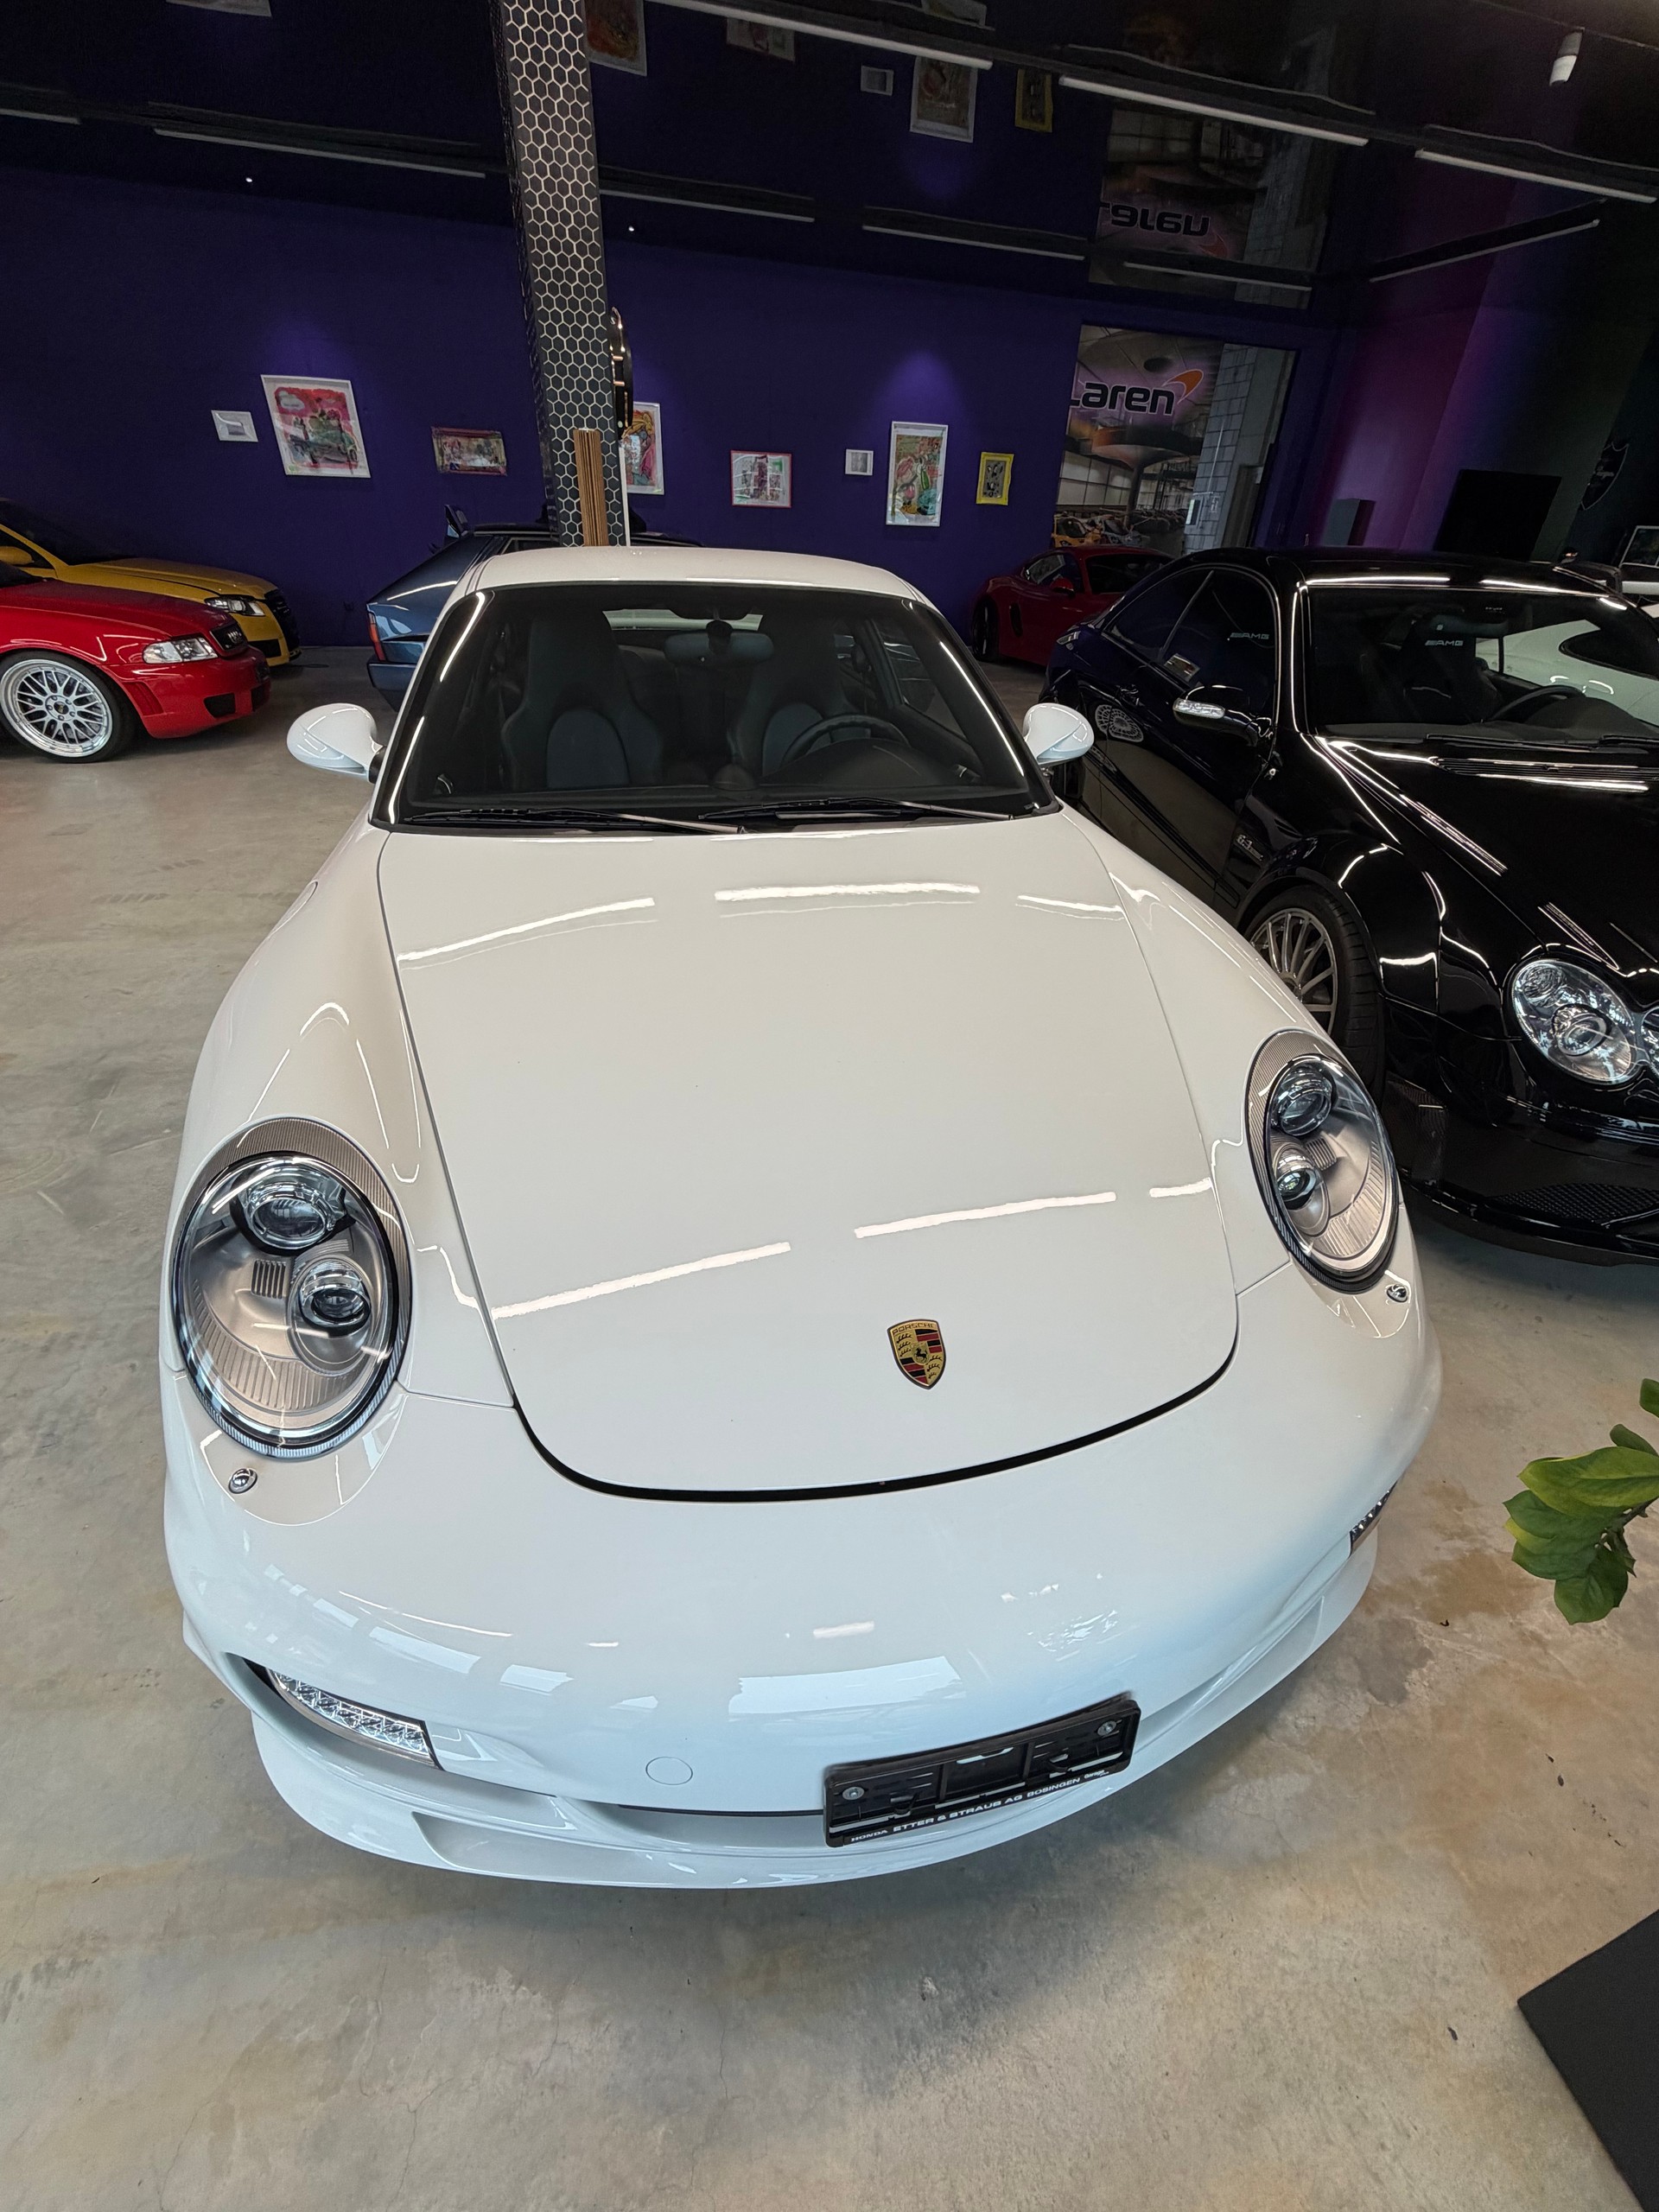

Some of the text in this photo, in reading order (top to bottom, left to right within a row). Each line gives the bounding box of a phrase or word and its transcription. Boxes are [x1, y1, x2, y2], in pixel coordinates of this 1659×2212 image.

[892, 1322, 938, 1336] PORSCHE
[850, 1829, 888, 1842] HONDA
[893, 1818, 935, 1833] ETTER
[949, 1800, 1002, 1819] STRAUB
[1004, 1794, 1023, 1804] AG
